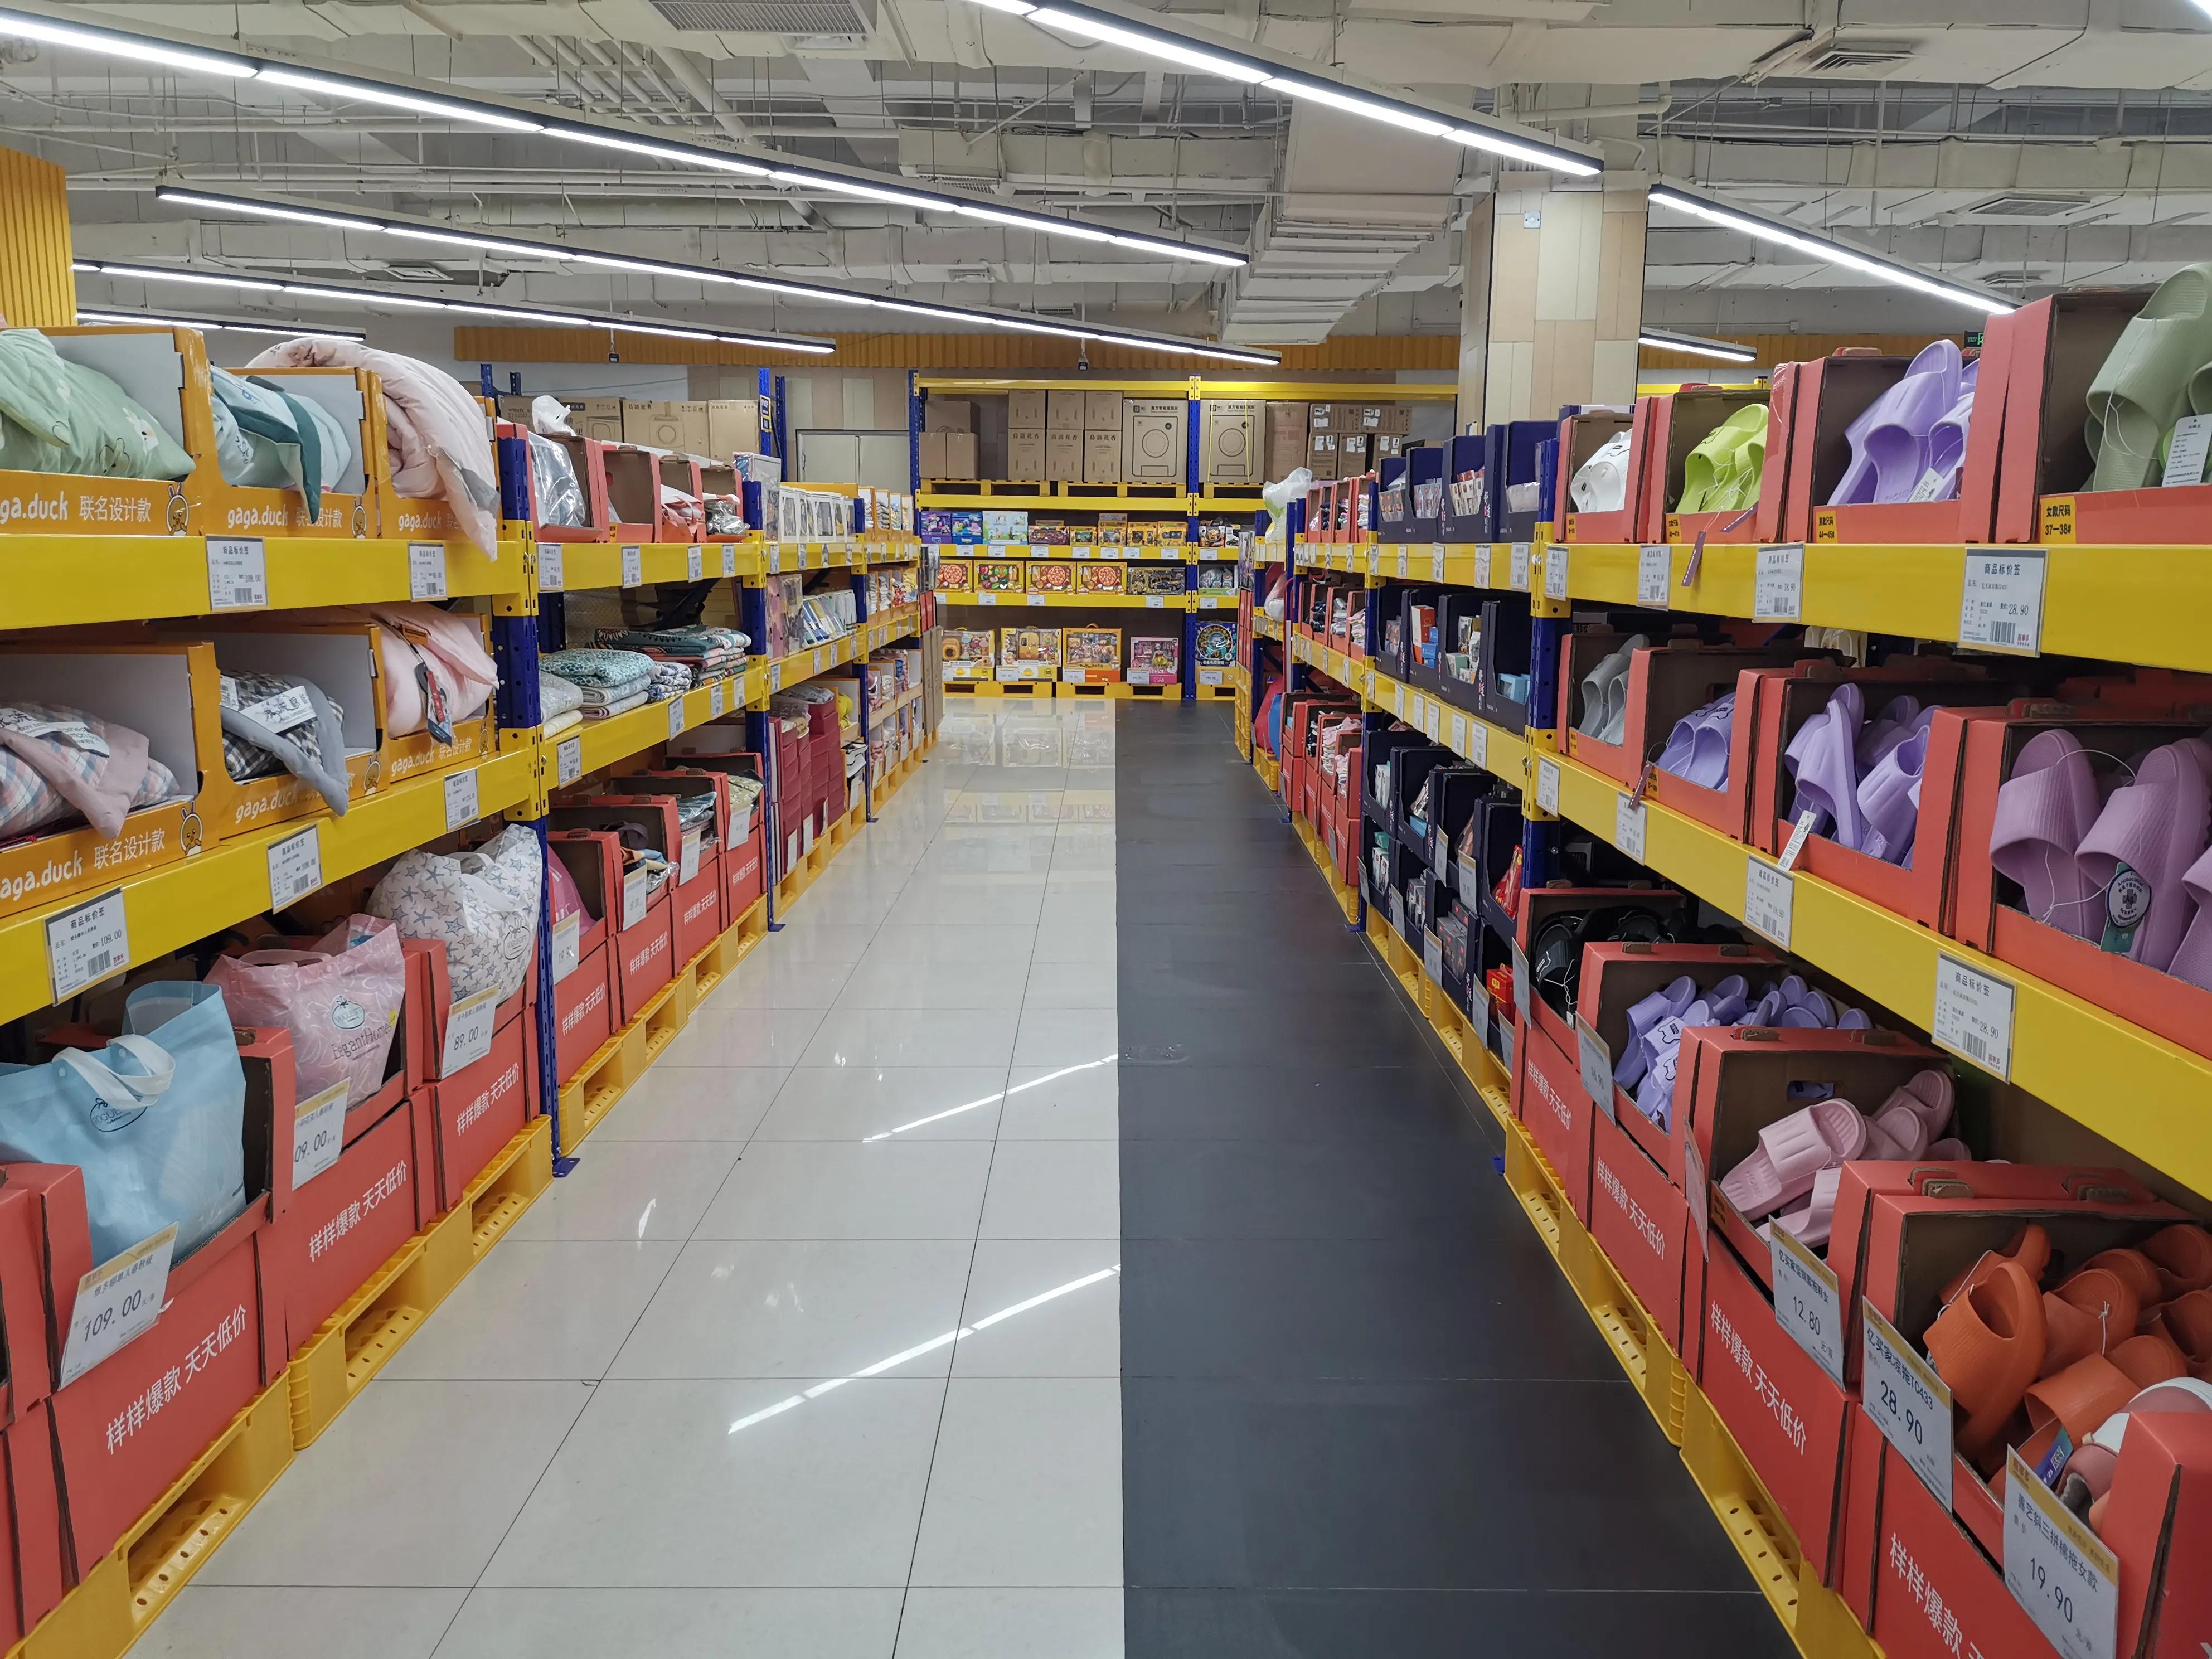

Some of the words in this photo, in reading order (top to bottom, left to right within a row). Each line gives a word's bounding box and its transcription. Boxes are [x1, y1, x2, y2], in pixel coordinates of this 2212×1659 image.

[79, 494, 151, 522] 联名设计款
[227, 503, 288, 529] gaga.duck
[295, 508, 342, 529] 联设计款
[399, 511, 442, 532] gaga.duck
[1985, 563, 2021, 575] 商品标价签
[2009, 604, 2029, 616] 28.90
[391, 746, 435, 777] gaga.duck
[235, 790, 298, 824] gaga.duck
[94, 827, 166, 870] 联名设计款
[70, 906, 105, 930] 商品标价签
[101, 929, 122, 947] 109.00
[1955, 972, 1990, 997] 商品标价签
[454, 1026, 479, 1050] 89.00
[1980, 1021, 1999, 1039] 28.90
[457, 1090, 490, 1136] 样样爆款
[490, 1061, 519, 1105] 天天低价
[309, 1200, 361, 1263] 样样爆款
[363, 1160, 406, 1216] 天天低价
[1597, 1156, 1628, 1215] 样样爆款
[1629, 1197, 1665, 1260] 天天低价
[85, 1289, 142, 1342] 109.00
[1793, 1295, 1820, 1336] 12.80
[106, 1365, 182, 1455] 样样爆款
[185, 1304, 246, 1384] 天天低价
[1711, 1300, 1753, 1383] 样样爆款
[1755, 1364, 1807, 1456] 天天低价
[1880, 1380, 1923, 1445] 28.90
[1890, 1532, 1963, 1659] 样样爆款
[2030, 1557, 2073, 1624] 19.90
